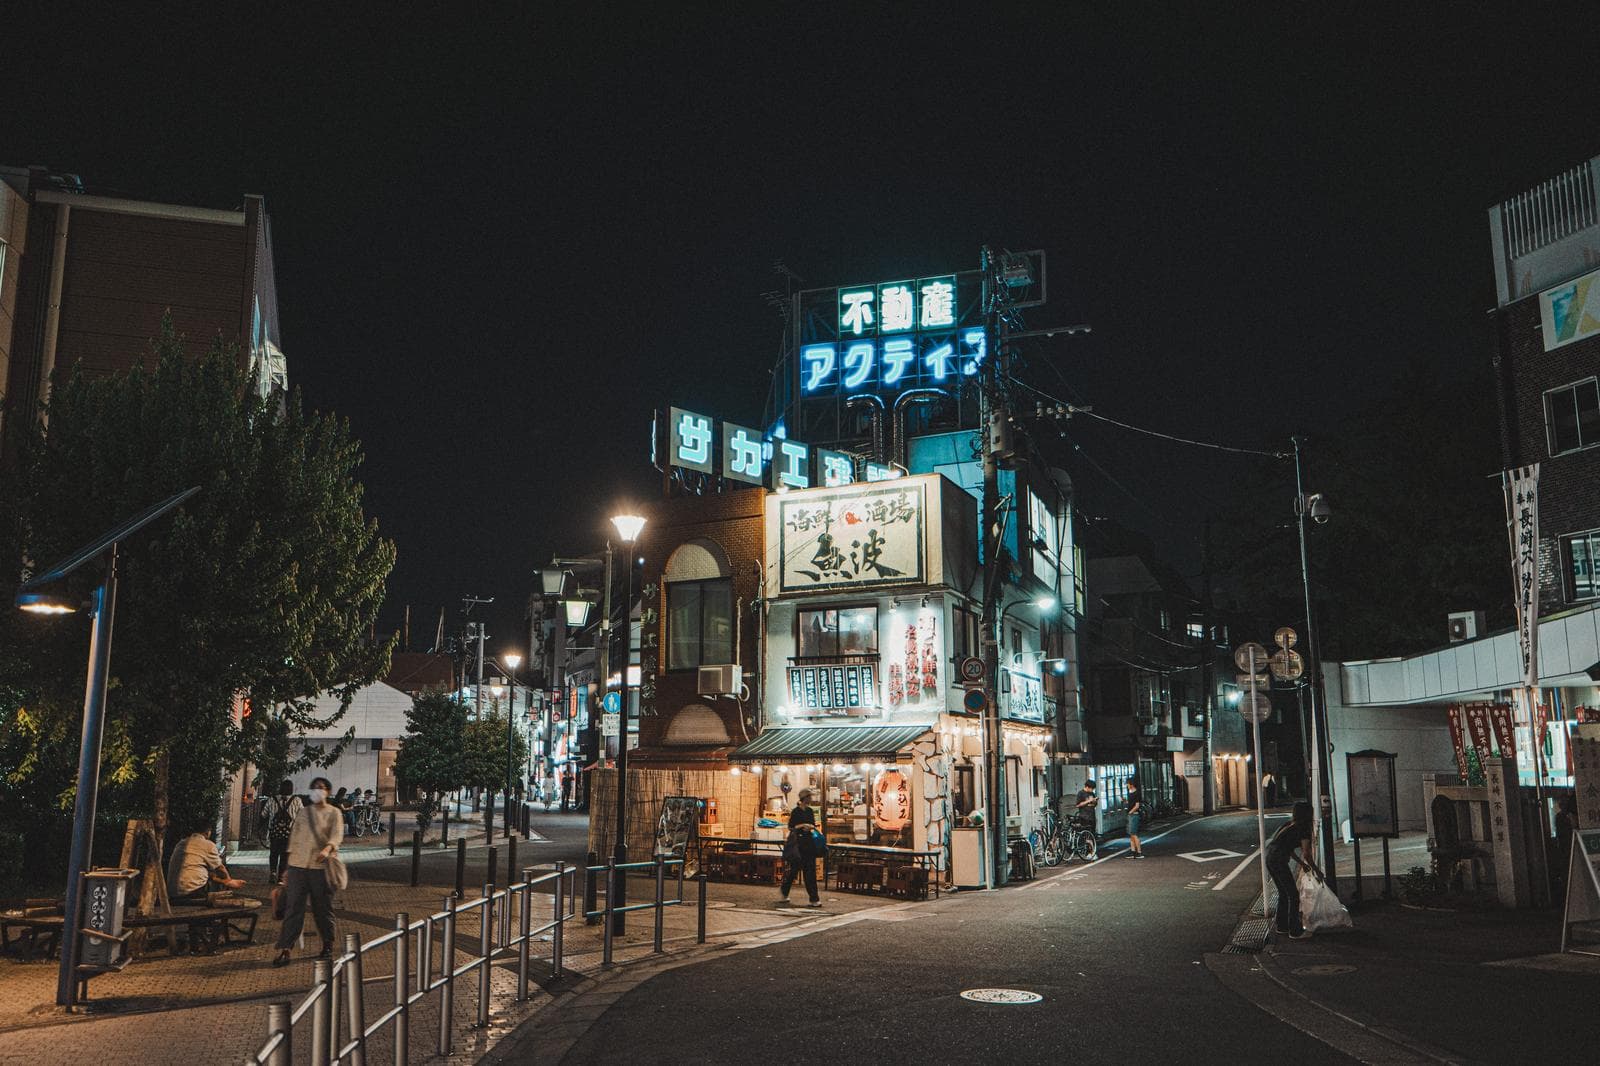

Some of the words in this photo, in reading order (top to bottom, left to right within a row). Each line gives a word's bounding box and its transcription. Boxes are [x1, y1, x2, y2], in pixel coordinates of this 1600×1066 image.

[842, 281, 953, 334] 不動産
[786, 502, 835, 534] 海鮮
[864, 495, 916, 527] 酒場
[967, 664, 980, 675] 20
